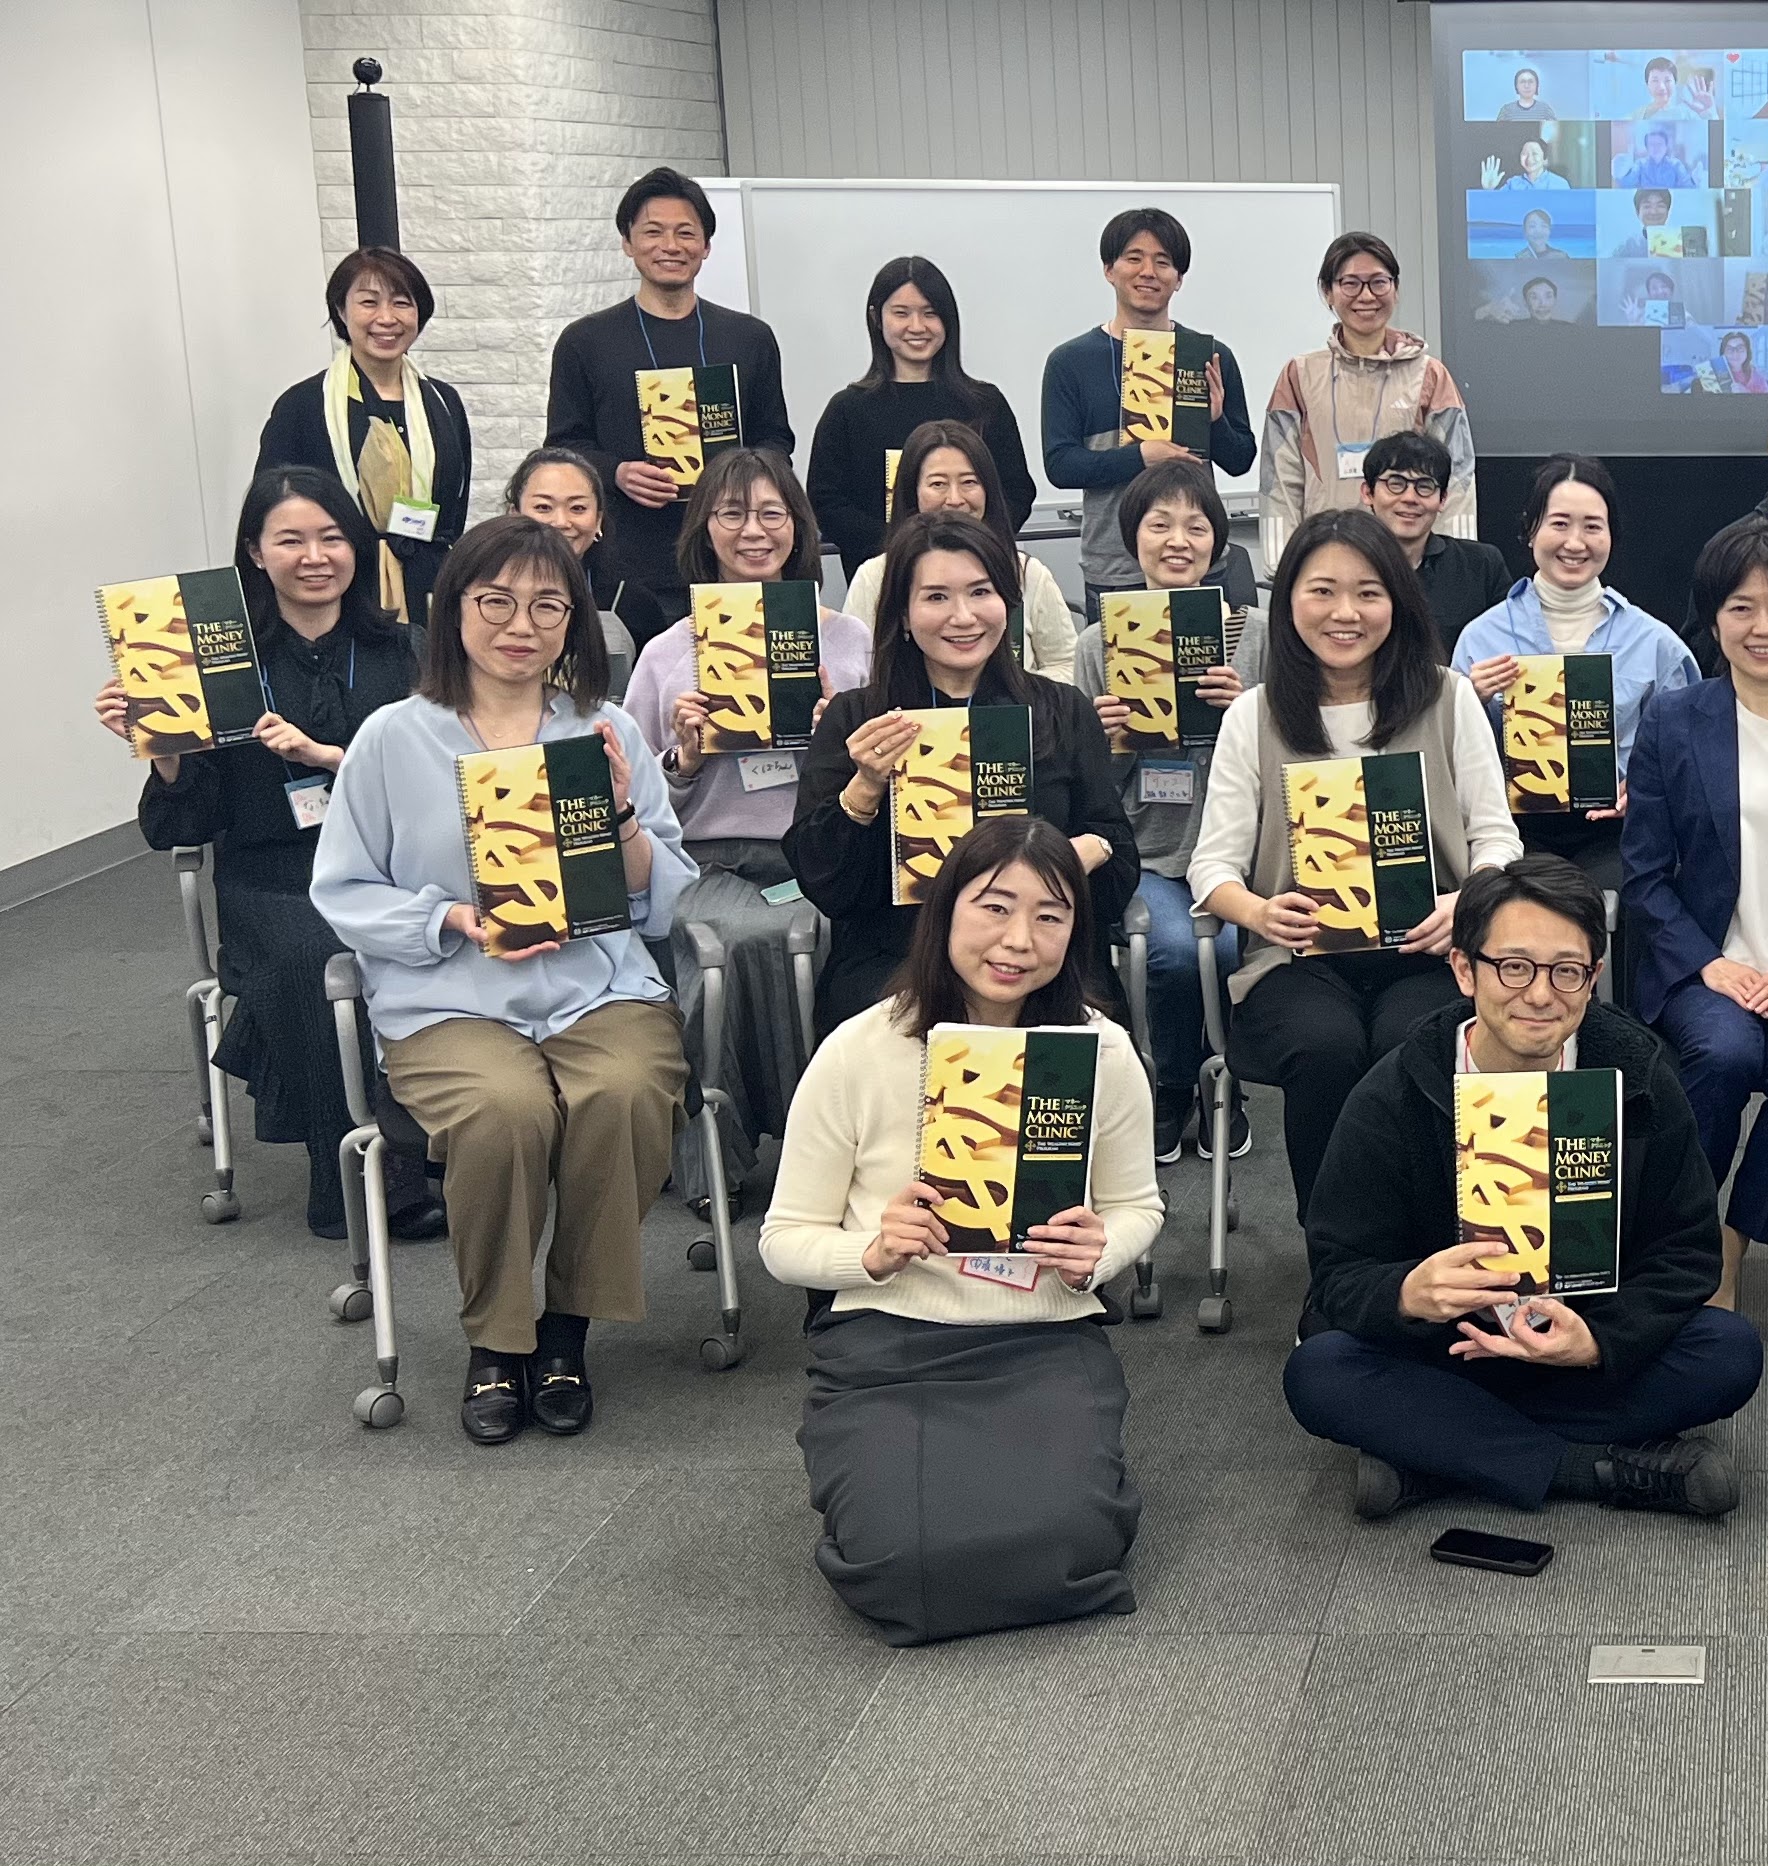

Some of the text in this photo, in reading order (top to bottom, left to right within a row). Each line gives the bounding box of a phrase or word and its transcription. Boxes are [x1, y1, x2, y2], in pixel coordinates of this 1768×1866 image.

[1177, 369, 1195, 378] THE
[1177, 377, 1208, 387] MONEY
[1176, 385, 1206, 394] CLINIC
[700, 404, 719, 413] THE
[702, 411, 734, 421] MONEY
[702, 419, 732, 430] CLINIC
[193, 622, 221, 634] THE
[197, 630, 243, 646] MONEY
[769, 630, 794, 641] THE
[1176, 636, 1200, 646] THE
[198, 641, 243, 657] CLINIC
[771, 641, 814, 651] MONEY
[1177, 645, 1219, 656] MONEY
[770, 651, 811, 662] CLINIC
[1177, 655, 1217, 666] CLINIC
[1569, 700, 1592, 710] THE
[1570, 710, 1609, 720] MONEY
[1570, 720, 1606, 730] CLINIC
[975, 762, 1004, 774] THE
[977, 773, 1026, 786] MONEY
[976, 785, 1022, 798] CLINIC
[556, 797, 586, 811] THE
[560, 806, 609, 824] MONEY
[1371, 811, 1400, 823] THE
[560, 818, 607, 837] CLINIC
[1374, 821, 1421, 835] MONEY
[1374, 833, 1419, 847] CLINIC
[1027, 1097, 1060, 1110] THE
[1026, 1111, 1085, 1125] MONEY
[1025, 1125, 1077, 1139] CLINIC
[1554, 1137, 1586, 1151] THE
[1555, 1151, 1610, 1166] MONEY
[1555, 1165, 1606, 1180] CLINIC
